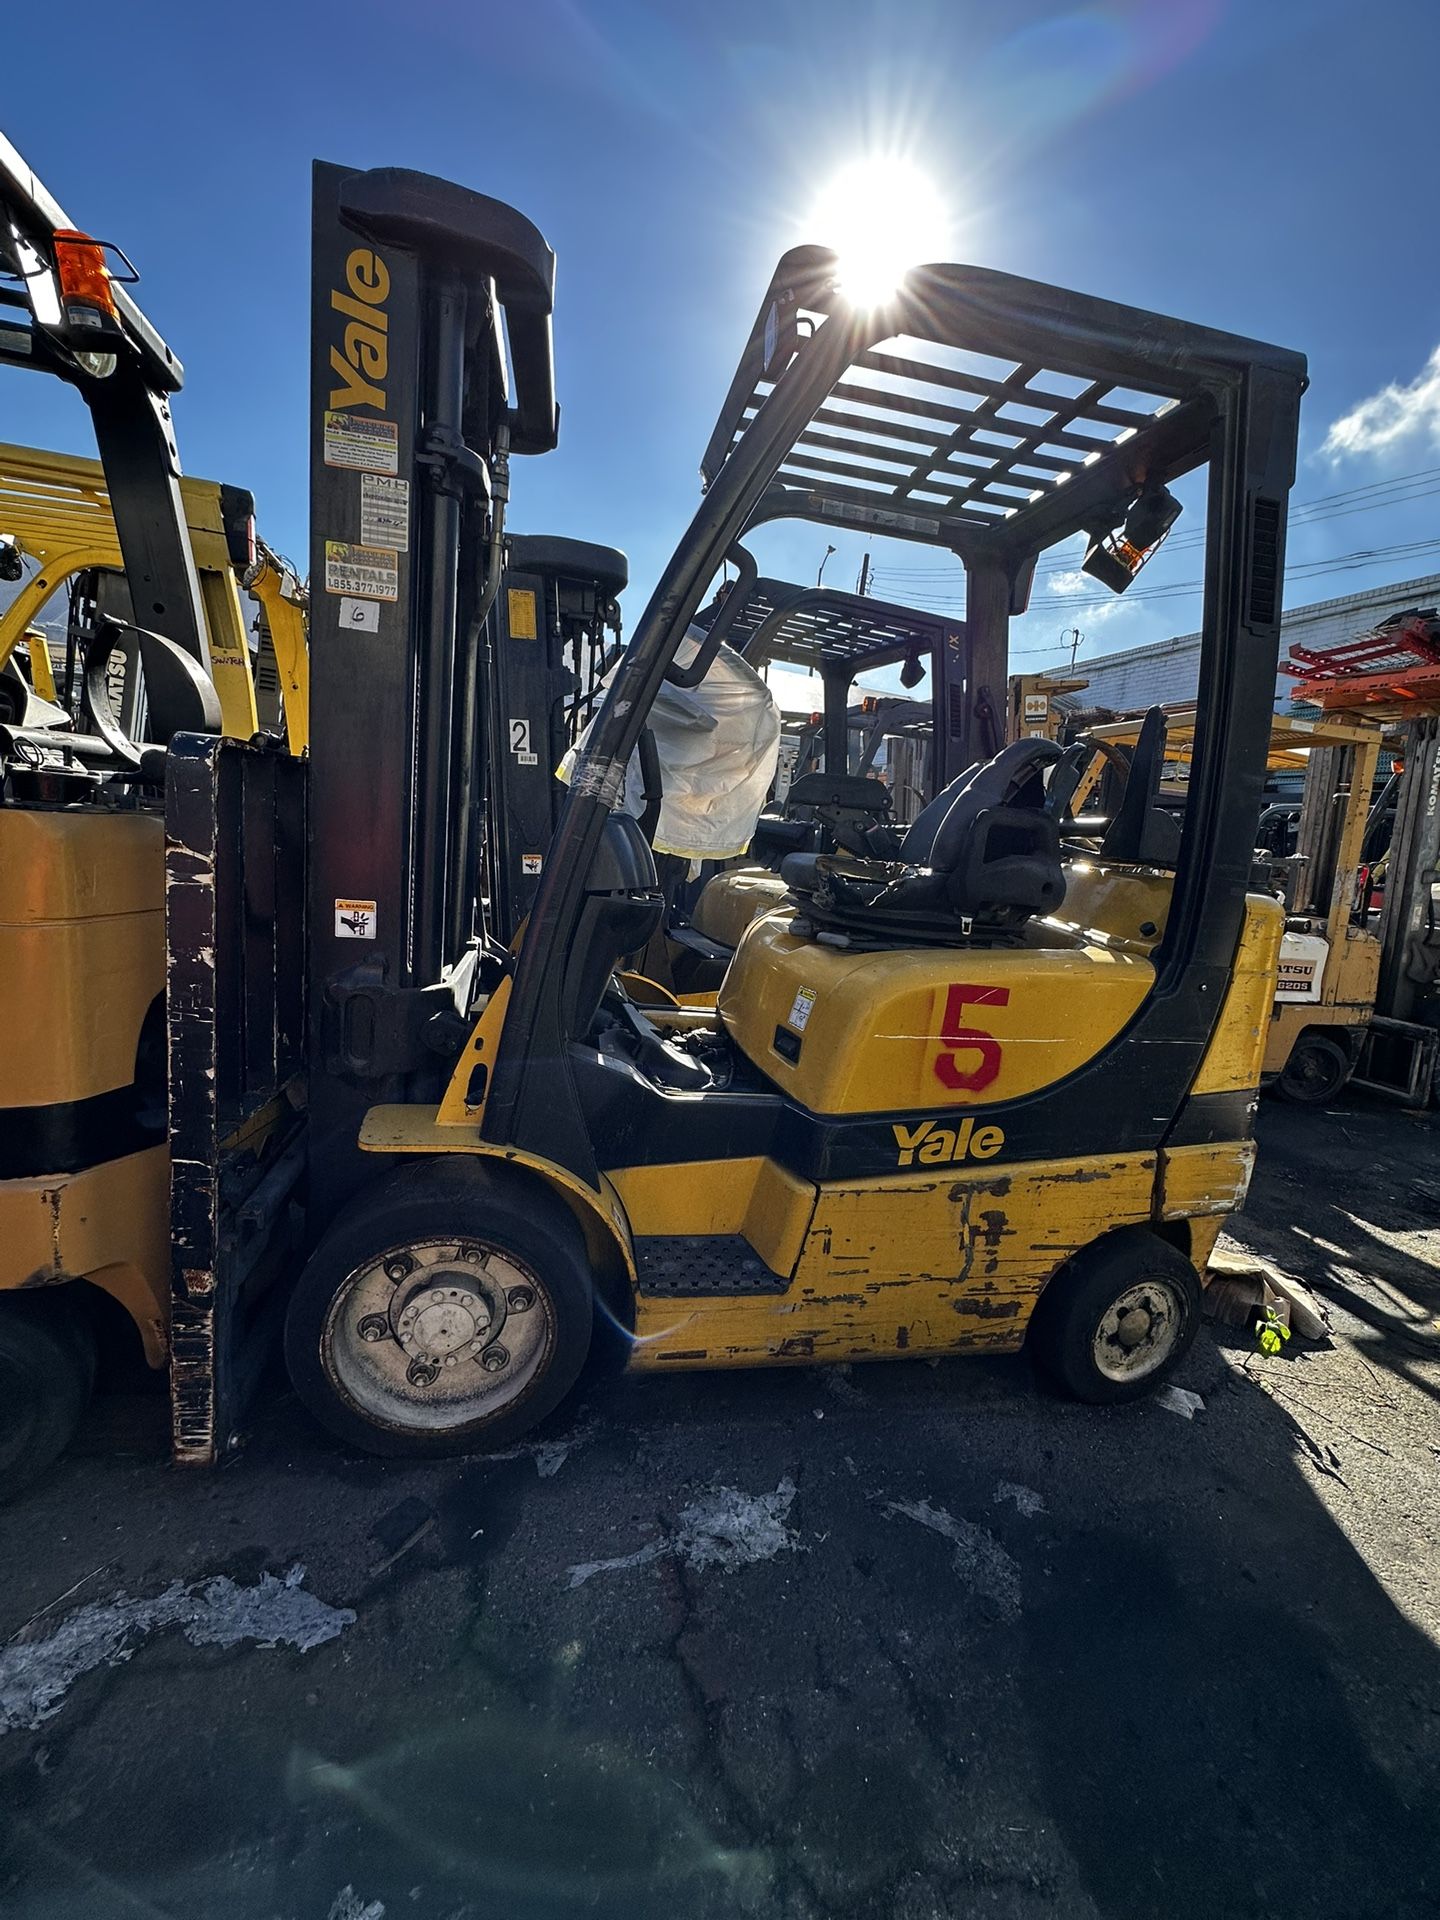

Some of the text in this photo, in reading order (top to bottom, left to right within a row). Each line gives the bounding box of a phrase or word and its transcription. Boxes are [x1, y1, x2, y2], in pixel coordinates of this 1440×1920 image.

[329, 248, 391, 411] Yale
[327, 578, 397, 596] 1.855.377.1977
[328, 563, 396, 585] RENTALS
[352, 606, 365, 622] 6
[512, 721, 527, 752] 2
[934, 983, 1011, 1092] 5
[892, 1117, 1005, 1167] Yale
